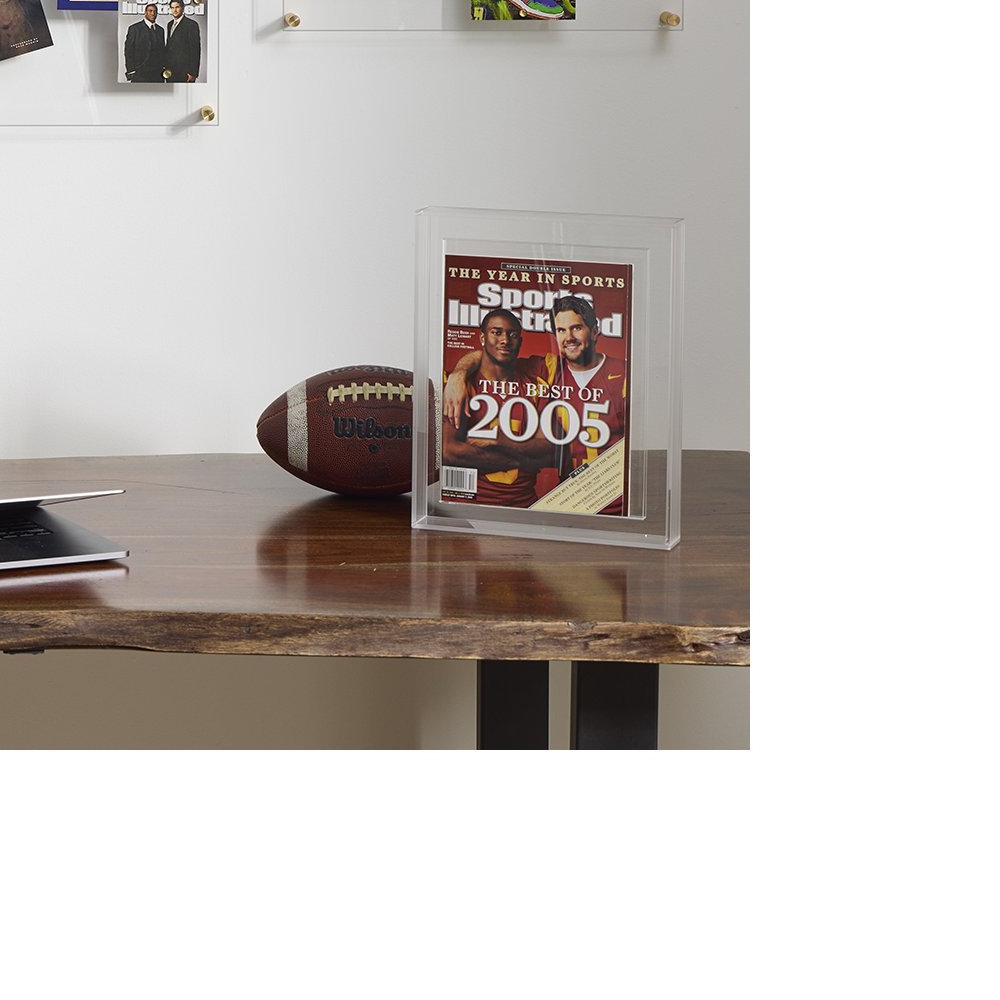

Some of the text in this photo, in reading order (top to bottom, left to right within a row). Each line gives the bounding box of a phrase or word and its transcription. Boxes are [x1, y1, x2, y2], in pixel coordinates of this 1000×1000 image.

[448, 267, 625, 289] THE YEAR IN SPORTS
[479, 380, 603, 402] THE BEST OF
[332, 416, 413, 440] Wilson
[467, 394, 610, 448] 2005
